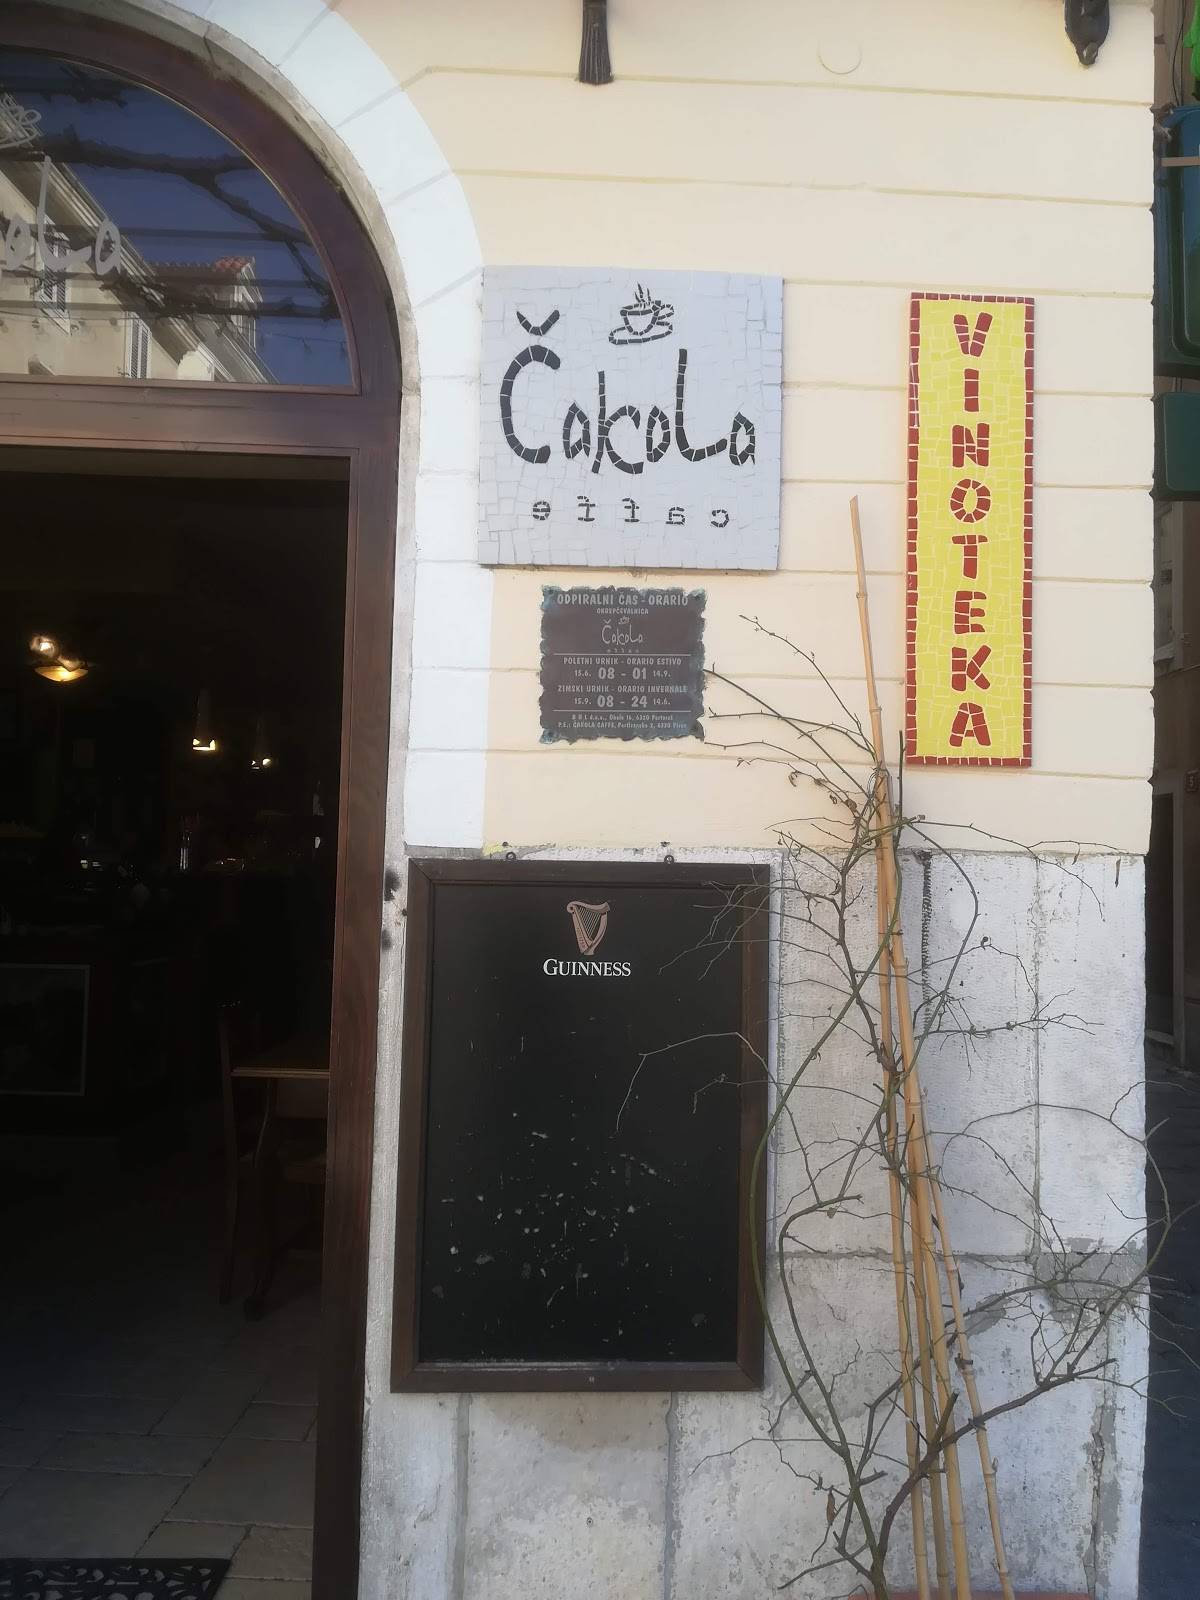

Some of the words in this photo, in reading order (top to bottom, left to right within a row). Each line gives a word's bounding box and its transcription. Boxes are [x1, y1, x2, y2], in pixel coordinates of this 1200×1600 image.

[949, 312, 993, 747] VINOTEKA
[557, 593, 614, 605] ODPIRALNI
[618, 591, 638, 605] ČAS
[649, 594, 688, 606] ORARIO
[563, 657, 593, 665] POLETNI
[595, 657, 618, 665] URNIK
[626, 657, 654, 665] ORARIO
[598, 667, 615, 679] 08
[632, 668, 647, 679] 01
[558, 685, 583, 693] ZIMSKI
[586, 685, 609, 693] URNIK
[617, 685, 645, 693] ORARIO
[647, 685, 688, 693] INVERNALE
[597, 695, 614, 707] 08
[631, 695, 648, 708] 24
